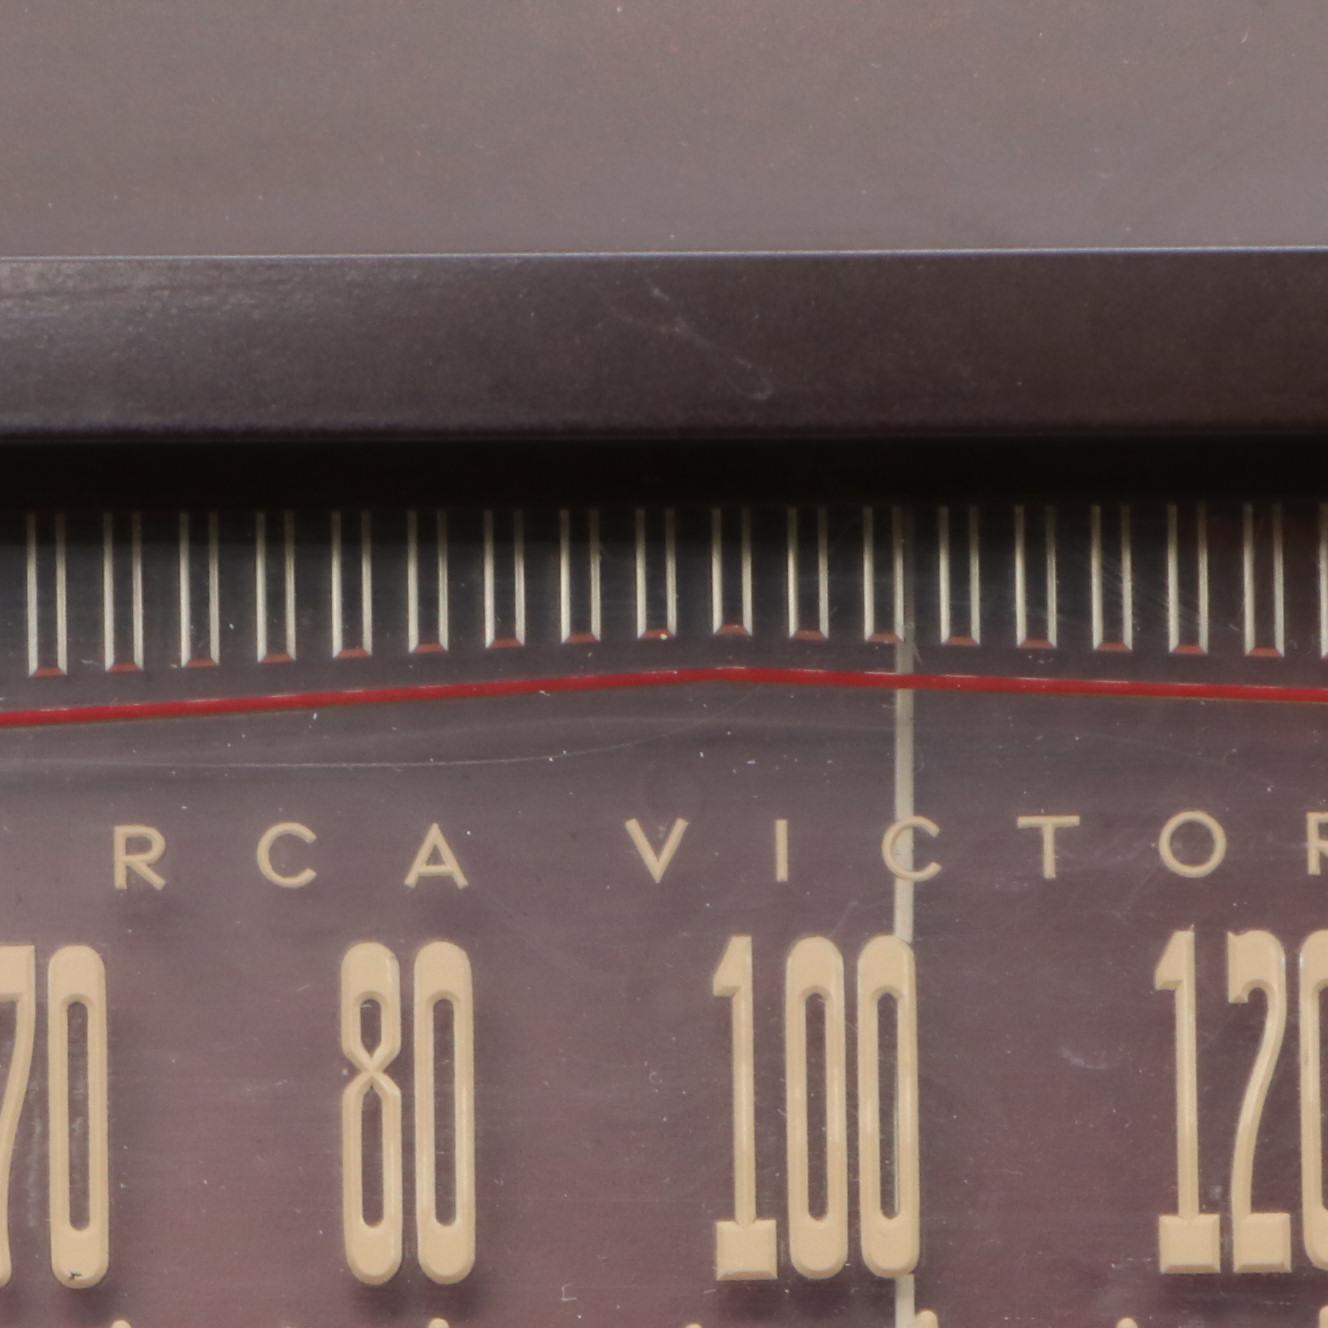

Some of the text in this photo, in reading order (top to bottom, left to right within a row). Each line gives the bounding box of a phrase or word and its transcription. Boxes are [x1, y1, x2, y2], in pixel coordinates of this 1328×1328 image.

[112, 822, 469, 890] RCA
[340, 941, 475, 1286] 80
[713, 934, 920, 1281] 100
